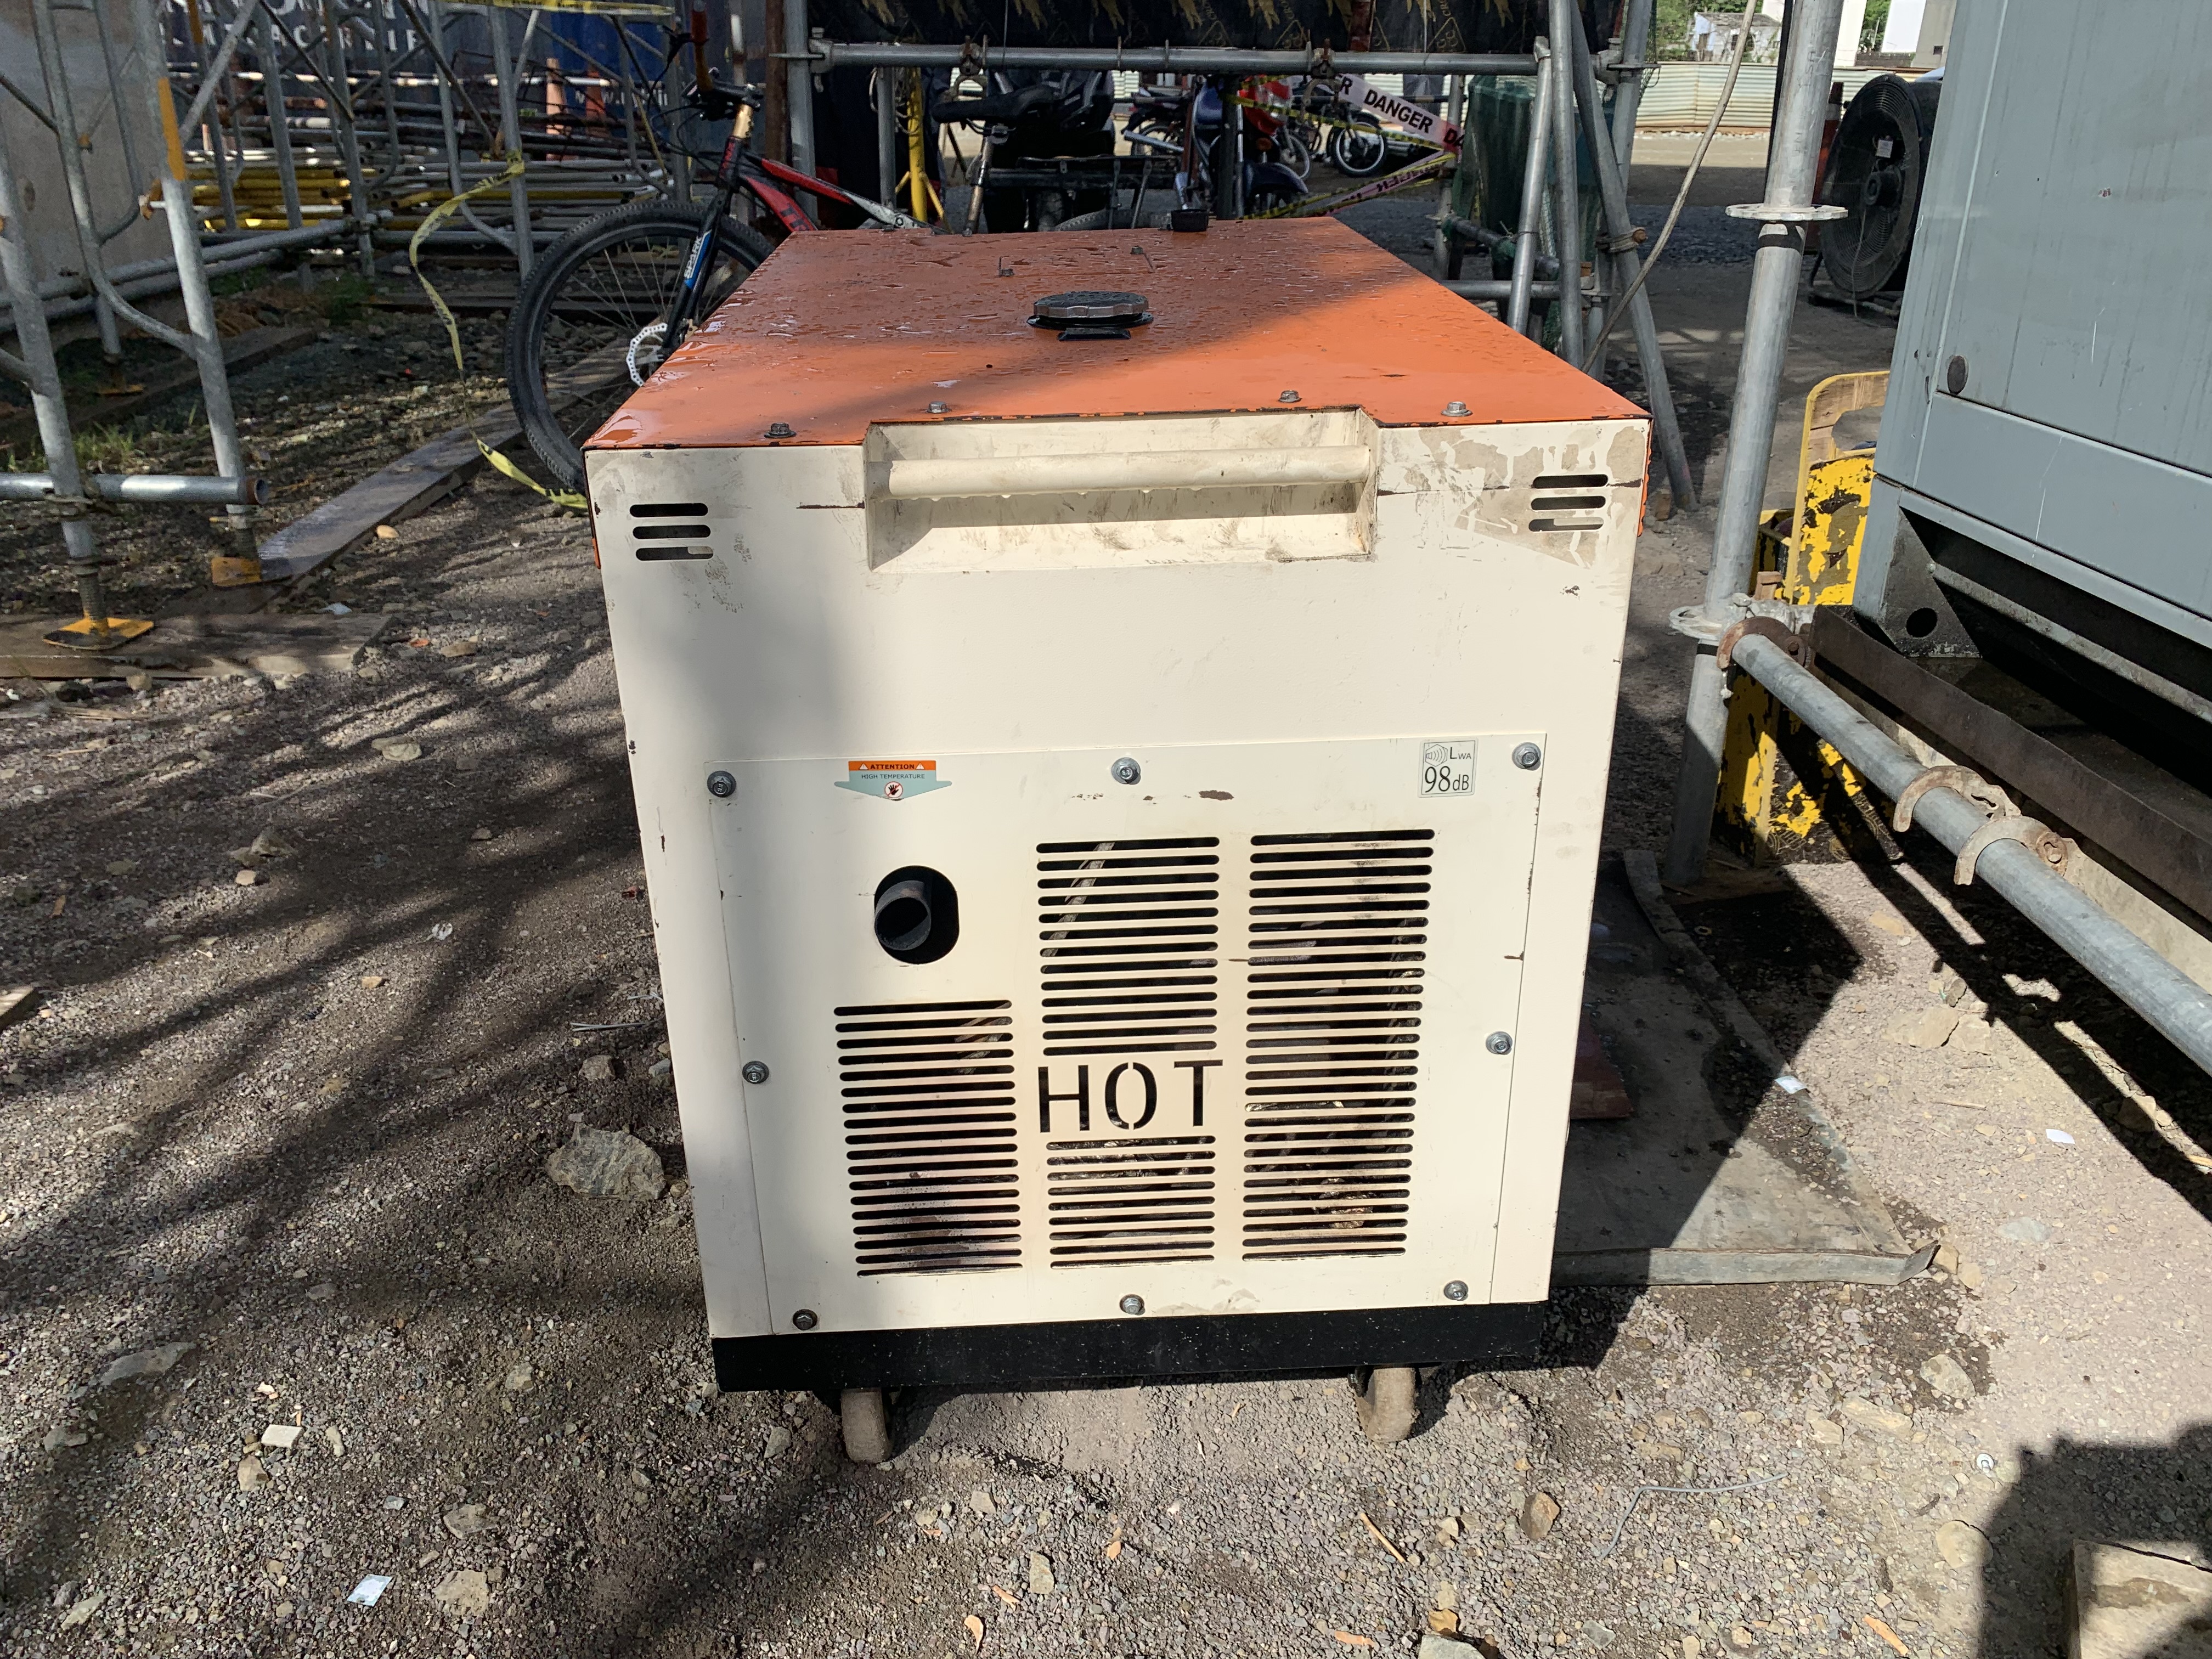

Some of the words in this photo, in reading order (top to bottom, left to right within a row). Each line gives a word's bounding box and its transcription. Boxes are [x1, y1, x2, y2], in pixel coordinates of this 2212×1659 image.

[1364, 89, 1433, 133] DANGER
[684, 236, 703, 279] SPARK
[1038, 1059, 1223, 1133] HOT
